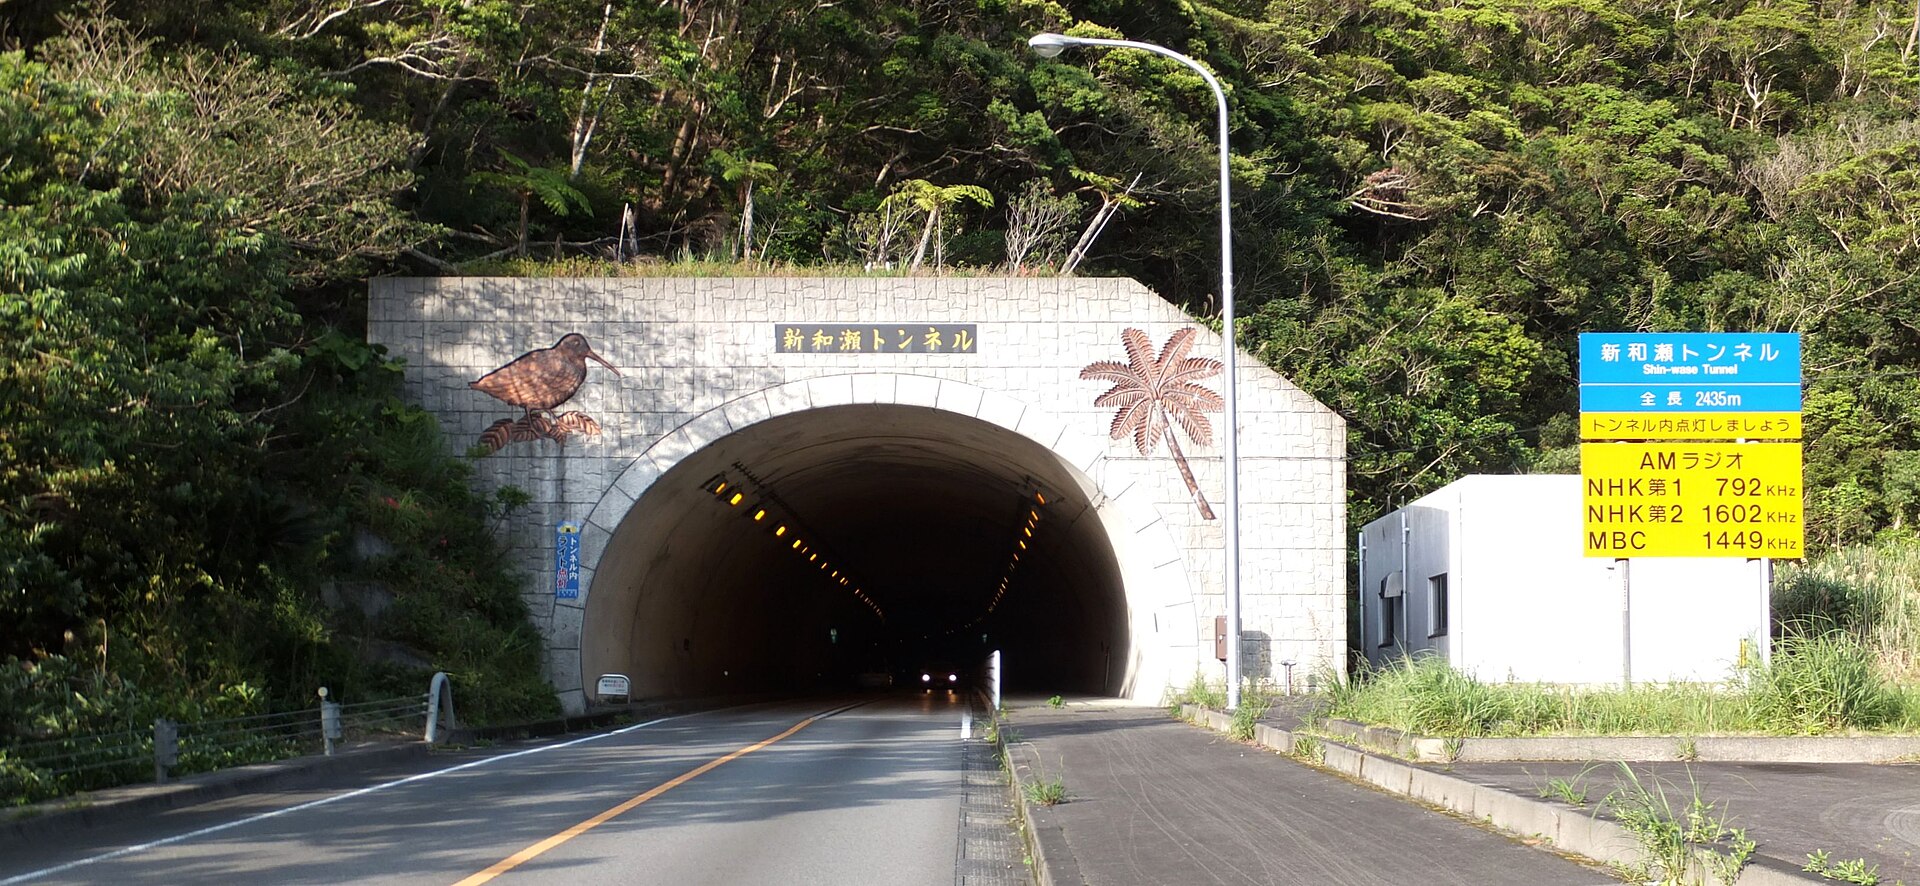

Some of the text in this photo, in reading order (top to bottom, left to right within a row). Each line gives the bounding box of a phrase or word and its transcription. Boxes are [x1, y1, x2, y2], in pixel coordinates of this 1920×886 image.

[783, 326, 974, 351] 新和瀬トンネル
[1600, 342, 1780, 363] 新和瀬トンネル
[1643, 363, 1738, 375] Shin-wase Tunnel
[1640, 390, 1741, 407] 全長 2435m
[1592, 418, 1791, 433] トンネル内点灯しましょう
[1640, 451, 1744, 470] AMラジオ
[1588, 477, 1796, 497] NHK第1 792 KHz
[1588, 504, 1796, 524] NHK第2 1602 KHz
[1589, 531, 1797, 550] MBC 1449 KHz
[569, 536, 578, 581] トンネル内
